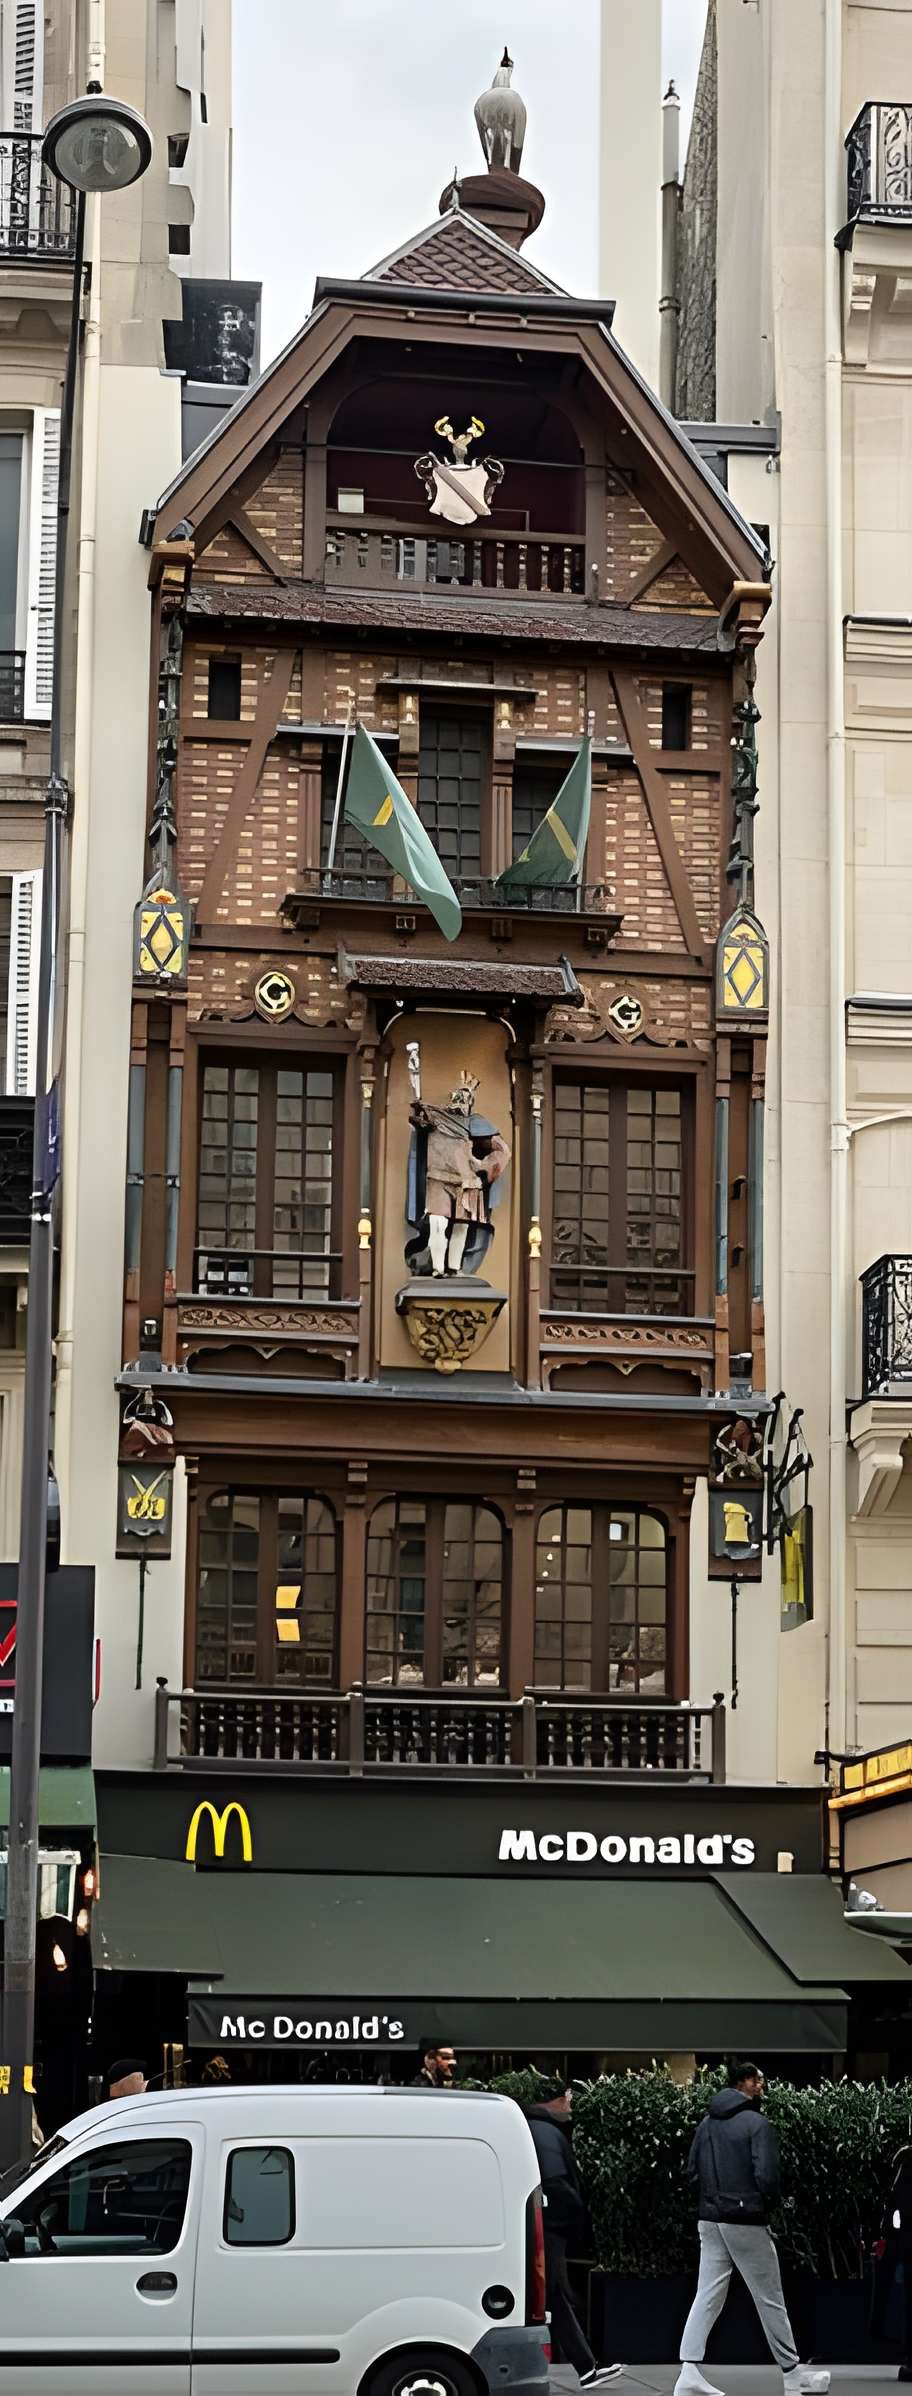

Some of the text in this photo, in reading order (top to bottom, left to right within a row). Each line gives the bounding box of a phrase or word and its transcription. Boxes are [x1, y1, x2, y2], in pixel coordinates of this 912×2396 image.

[498, 1829, 755, 1865] McDonald's
[220, 2015, 405, 2040] Mc Donald's
